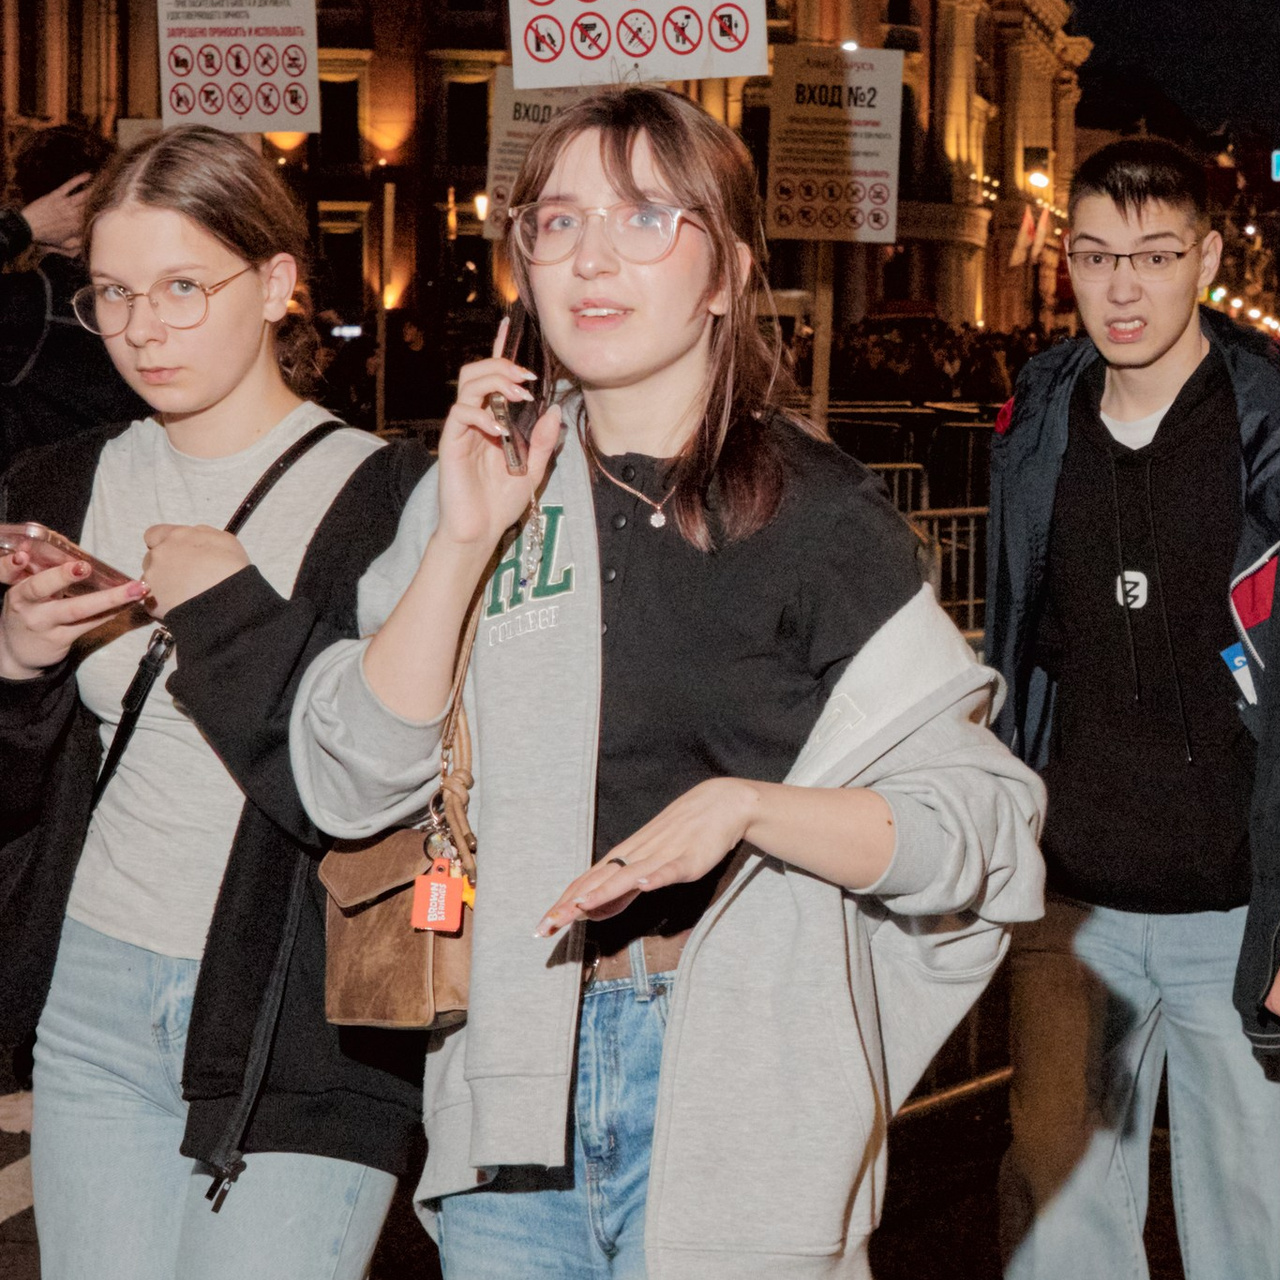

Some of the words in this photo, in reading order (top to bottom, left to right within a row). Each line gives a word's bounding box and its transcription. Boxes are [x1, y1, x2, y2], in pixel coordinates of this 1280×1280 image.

[795, 83, 843, 109] ВХОД
[847, 85, 877, 108] №2
[513, 102, 552, 124] ВХОД
[488, 606, 559, 647] COLLEGE
[427, 882, 438, 922] BROWN
